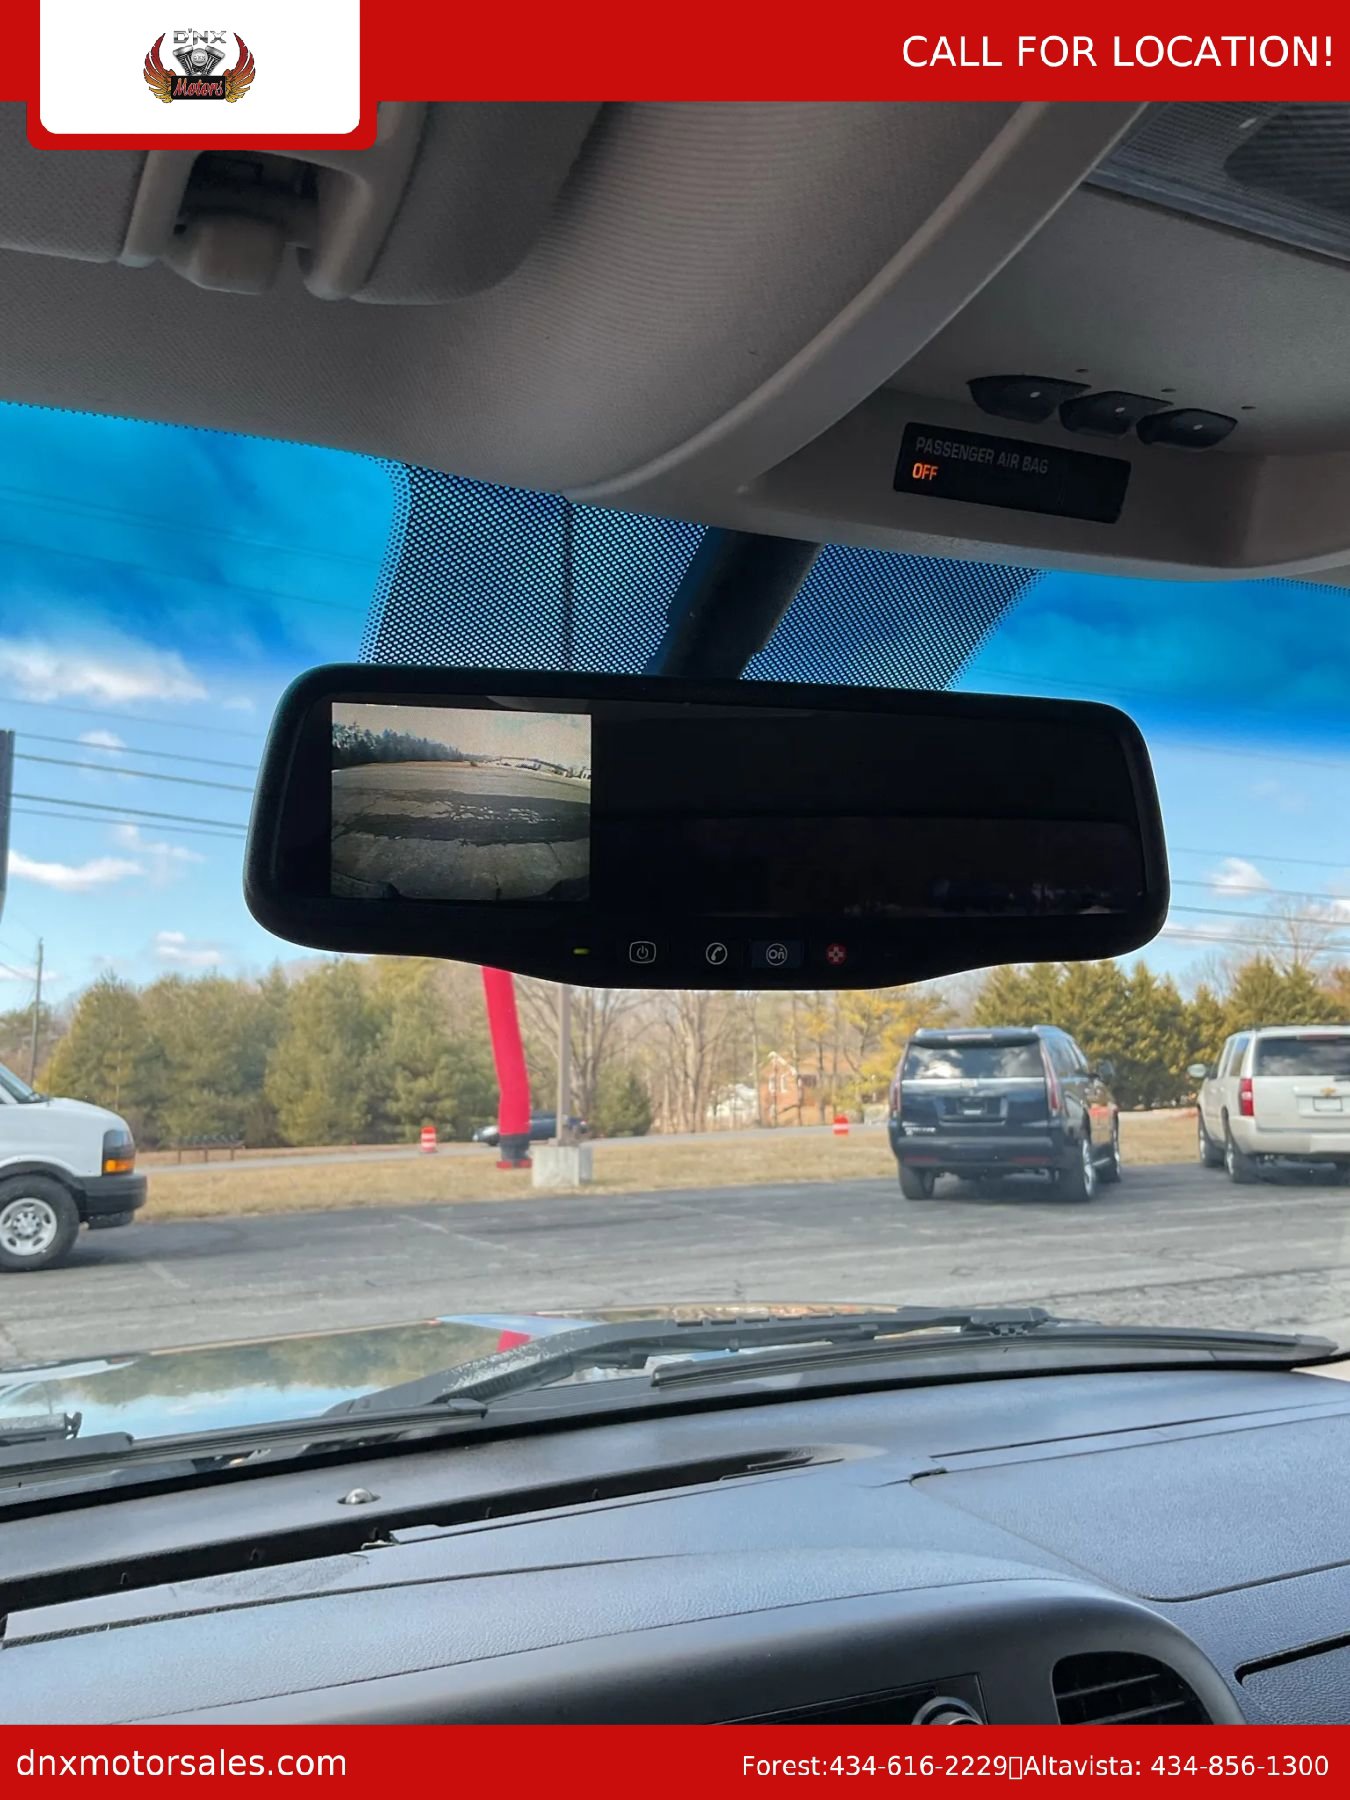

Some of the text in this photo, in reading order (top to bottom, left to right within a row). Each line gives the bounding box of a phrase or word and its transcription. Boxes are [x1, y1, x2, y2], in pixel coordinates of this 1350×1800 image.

[914, 436, 1049, 475] PASSENGER AIR BAG
[912, 463, 939, 481] OFF
